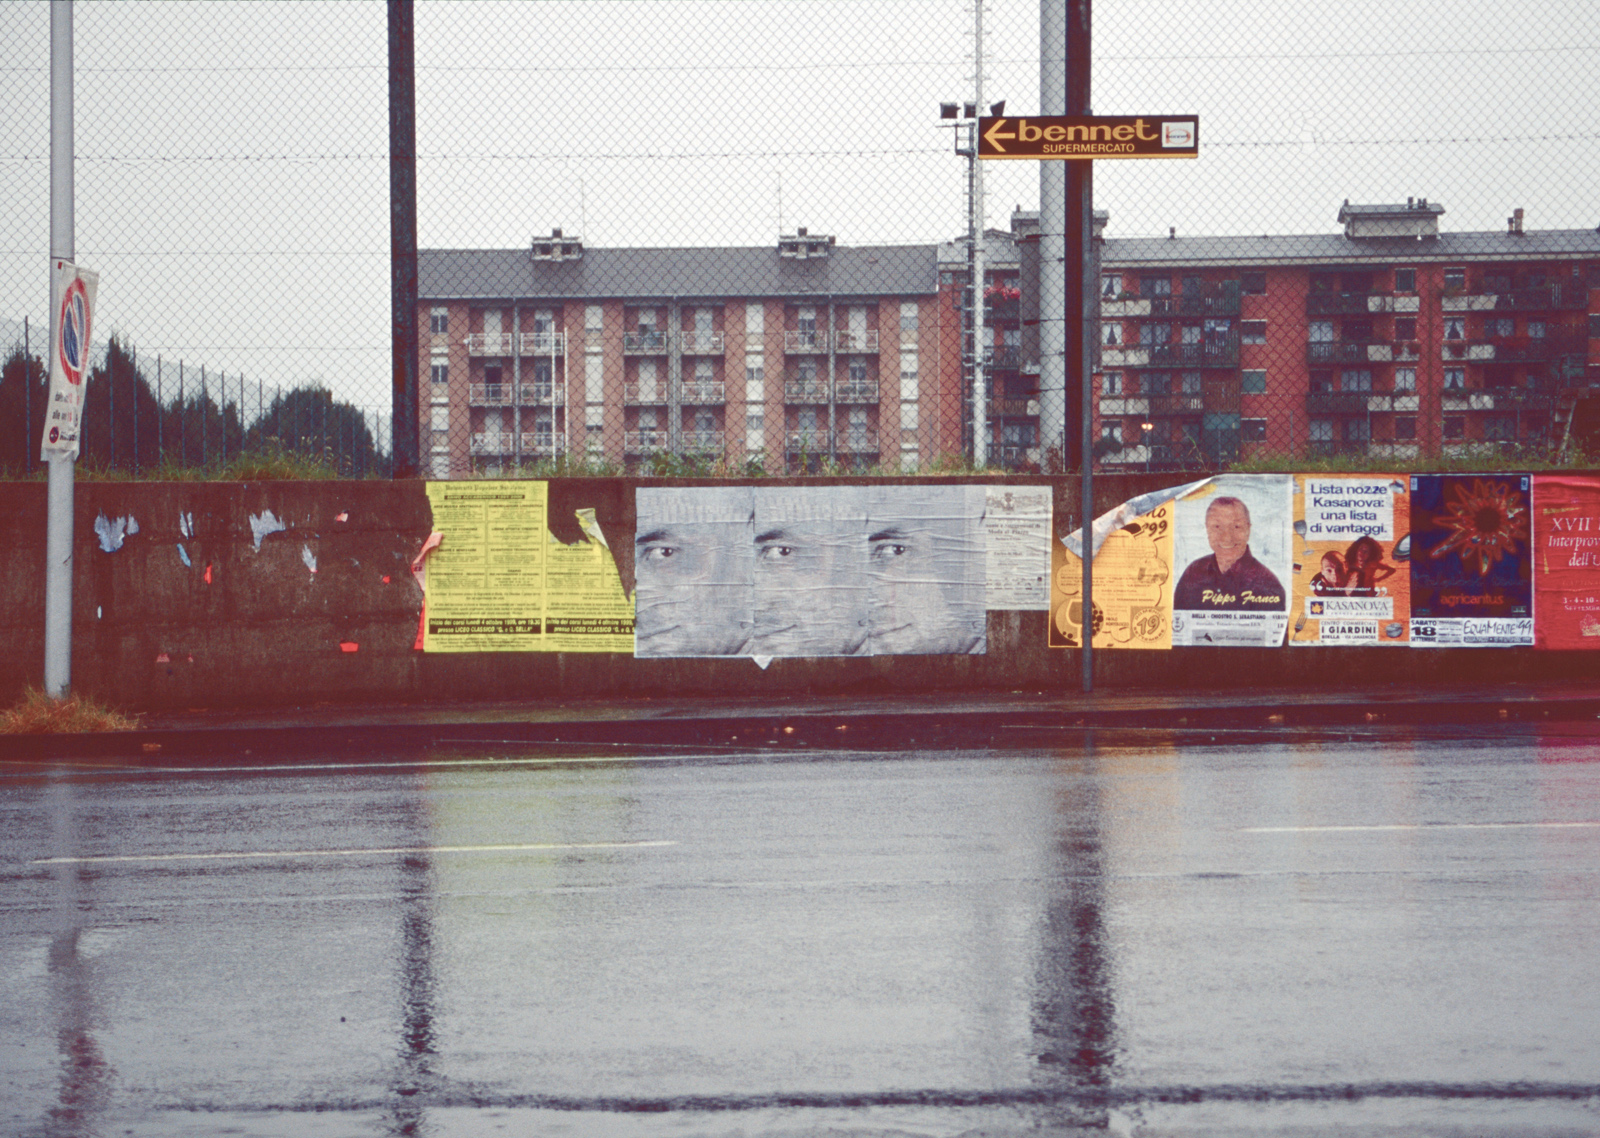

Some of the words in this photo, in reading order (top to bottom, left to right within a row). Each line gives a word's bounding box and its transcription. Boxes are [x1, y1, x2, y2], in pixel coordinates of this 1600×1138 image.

[1018, 118, 1159, 142] bennet
[1042, 143, 1135, 153] SUPERMERCATO
[1310, 483, 1343, 494] Lista
[1346, 485, 1388, 494] nozze
[1313, 497, 1385, 508] Kasanova:
[1320, 511, 1346, 520] una
[1349, 510, 1377, 520] lista
[1309, 523, 1322, 533] di
[1325, 523, 1388, 536] vantaggi.
[1201, 589, 1237, 606] Pippo
[1240, 590, 1281, 605] Franco
[1440, 594, 1504, 607] agricantus
[1326, 600, 1388, 611] KASANOVA
[1136, 614, 1161, 636] 19
[1321, 626, 1325, 634] I
[1328, 626, 1377, 634] GIARDINI
[1411, 626, 1437, 636] 18
